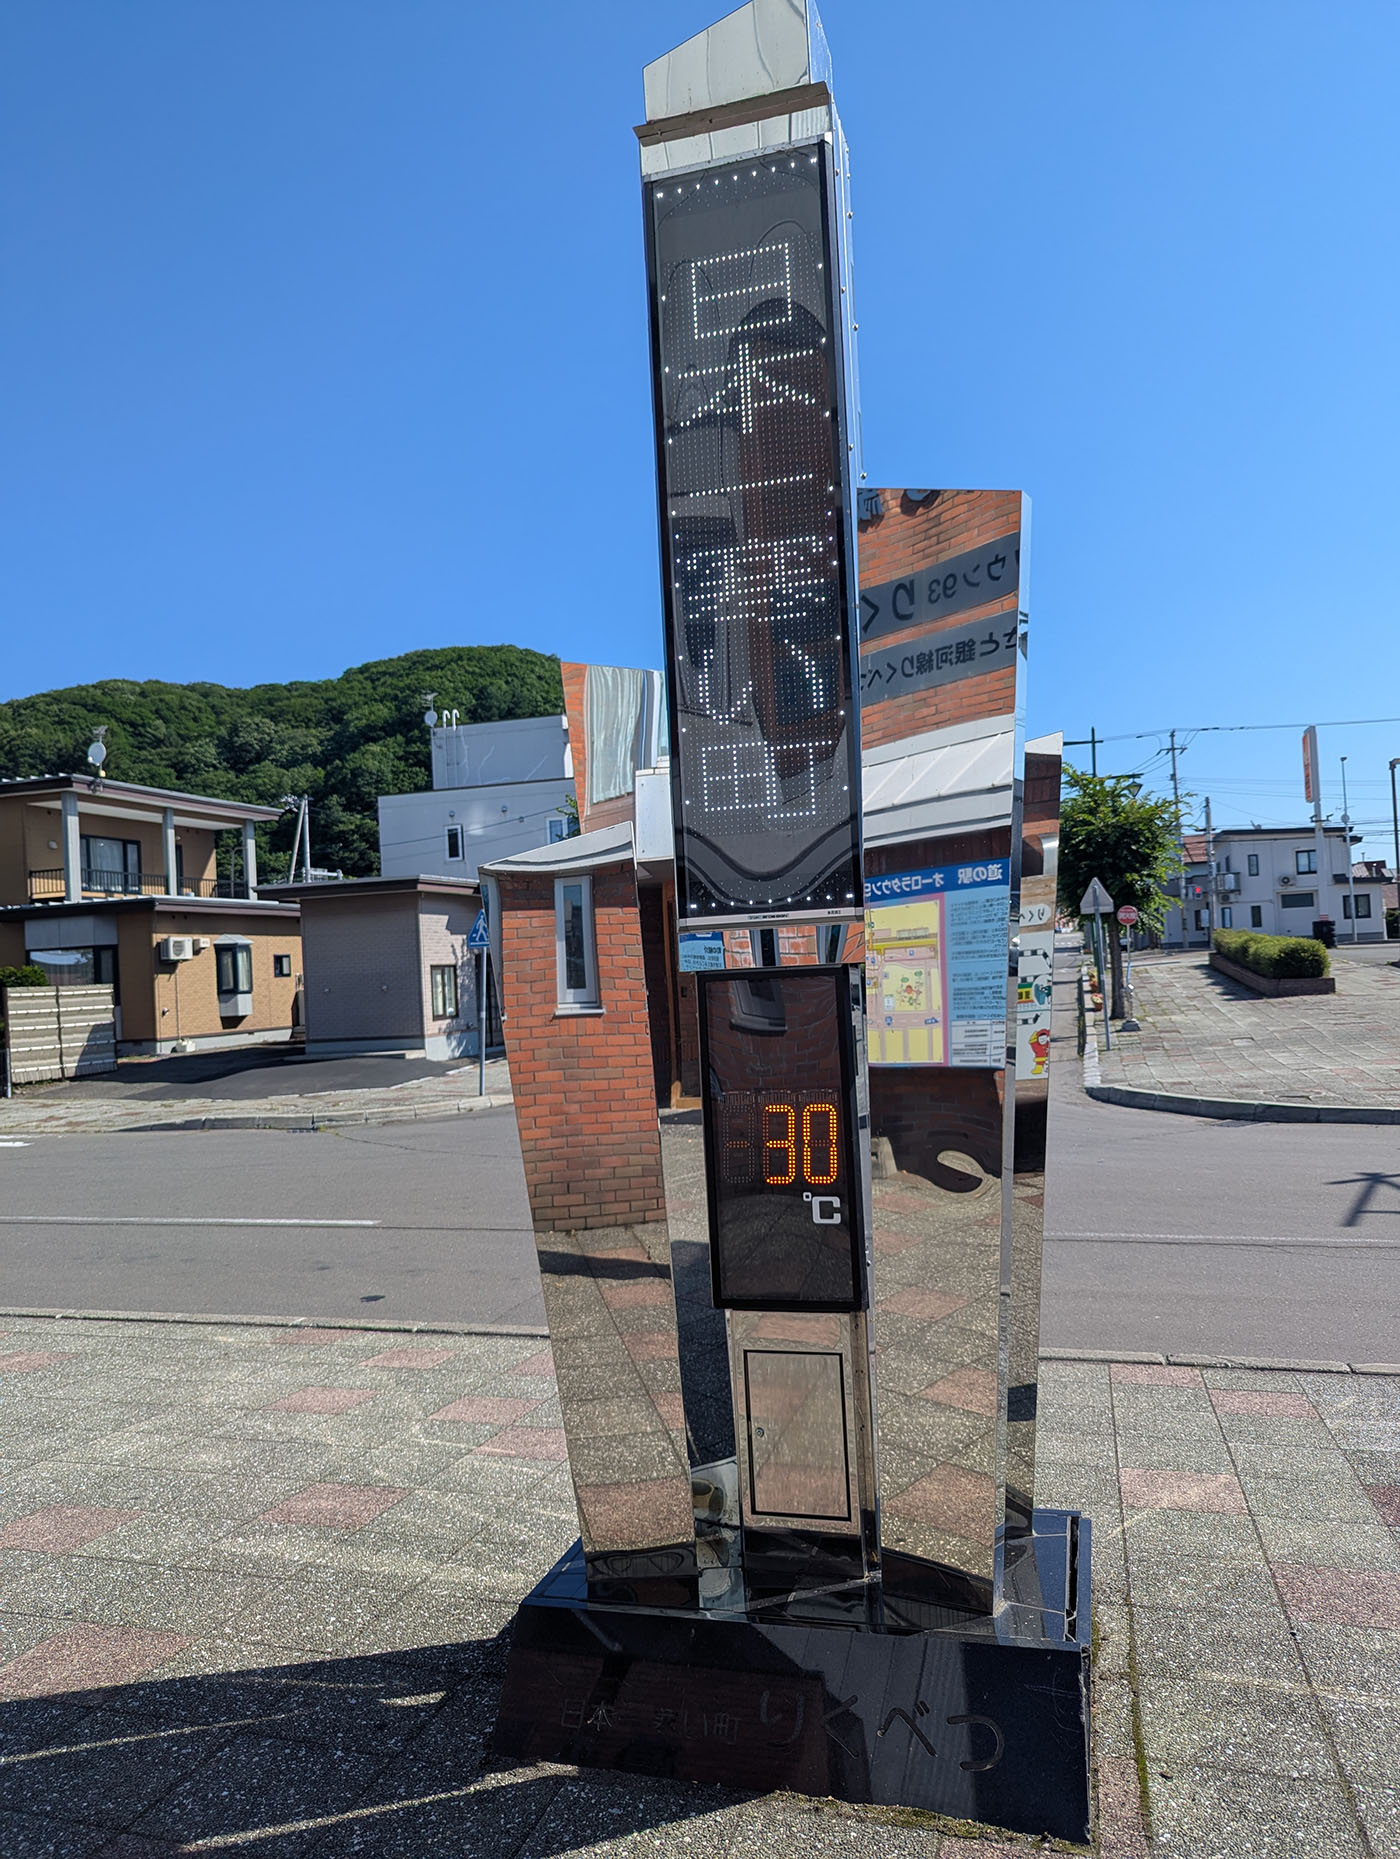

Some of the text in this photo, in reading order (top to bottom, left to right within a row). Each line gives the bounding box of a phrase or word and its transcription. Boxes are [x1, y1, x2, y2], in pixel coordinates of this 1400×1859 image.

[678, 241, 833, 818] 日本一寒い町
[763, 1103, 838, 1185] 30
[759, 1690, 1005, 1772] りくべつ
